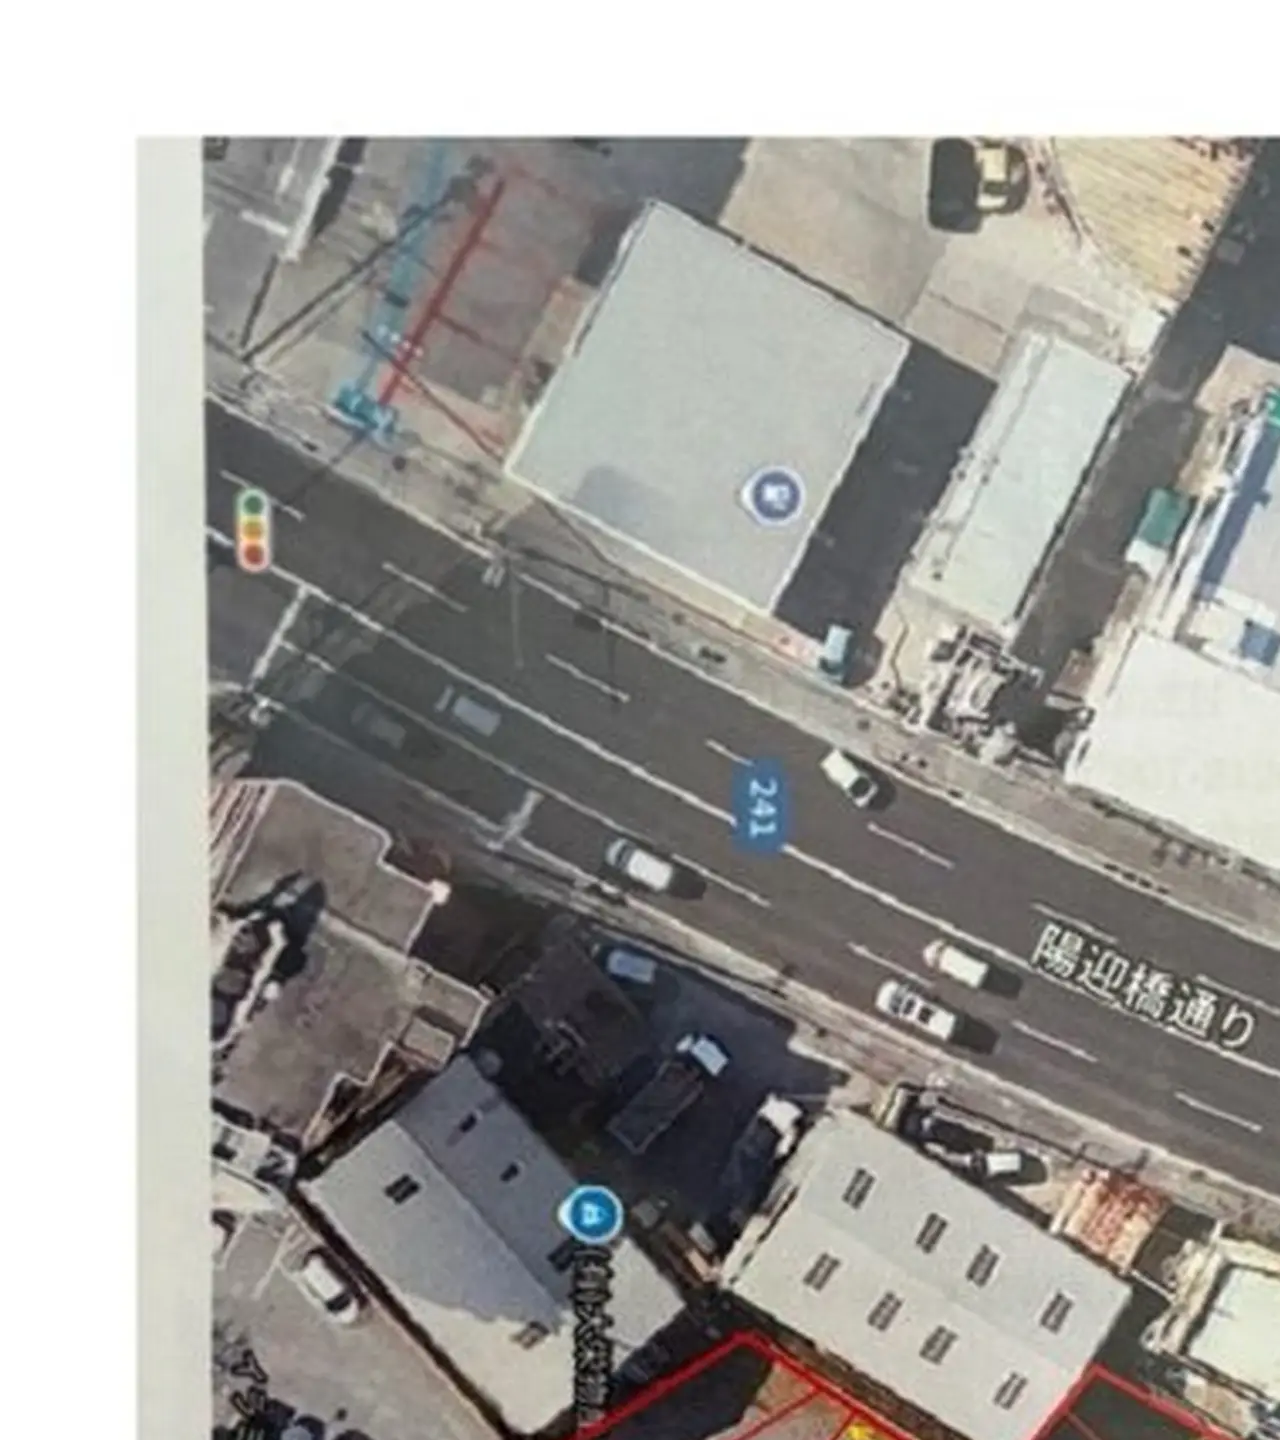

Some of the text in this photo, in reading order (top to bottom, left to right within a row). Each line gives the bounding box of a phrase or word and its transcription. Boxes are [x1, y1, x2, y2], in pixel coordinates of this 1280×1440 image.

[749, 776, 778, 840] 241
[1031, 922, 1255, 1048] 陽迎橋通り
